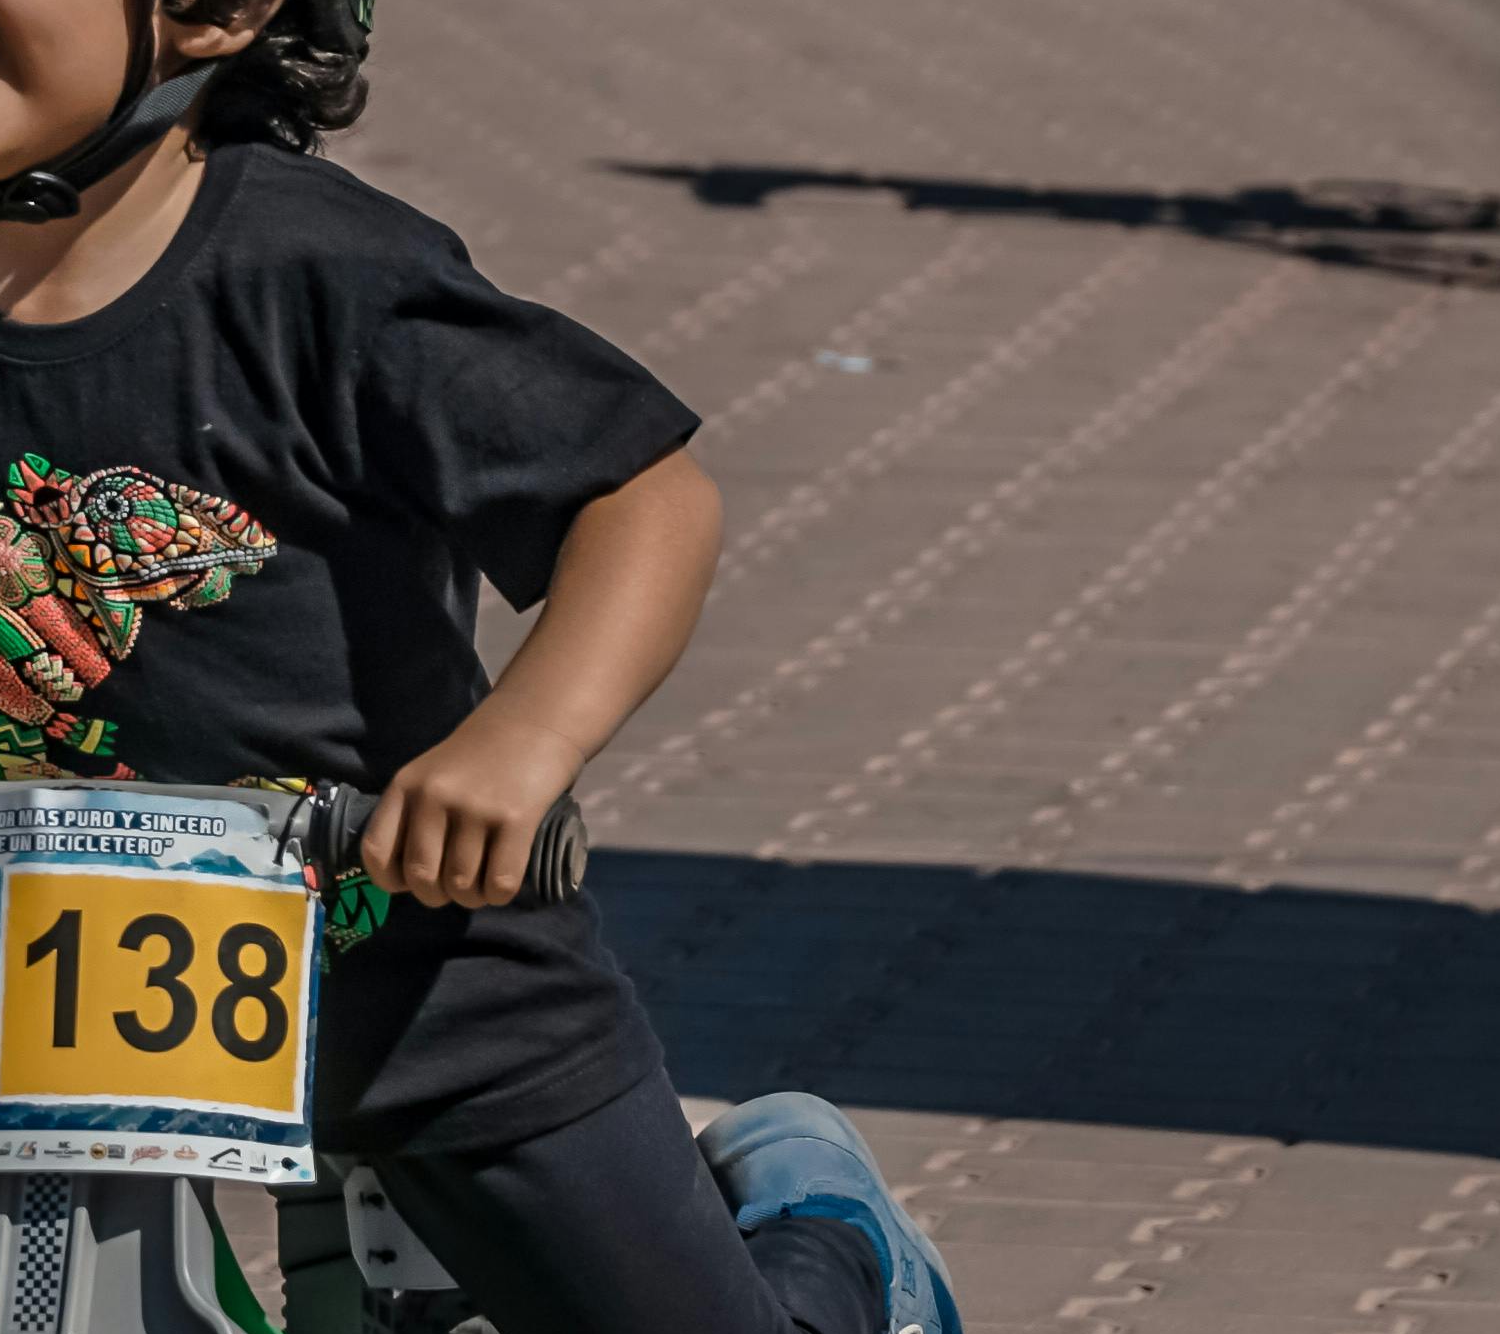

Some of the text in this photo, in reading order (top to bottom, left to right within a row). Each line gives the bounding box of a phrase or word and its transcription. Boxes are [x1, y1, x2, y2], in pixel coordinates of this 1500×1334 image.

[17, 808, 60, 828] MAS
[62, 808, 116, 829] PURO
[119, 810, 138, 829] Y
[139, 811, 227, 837] SINCERO
[8, 834, 32, 853] UN
[25, 908, 290, 1063] 138
